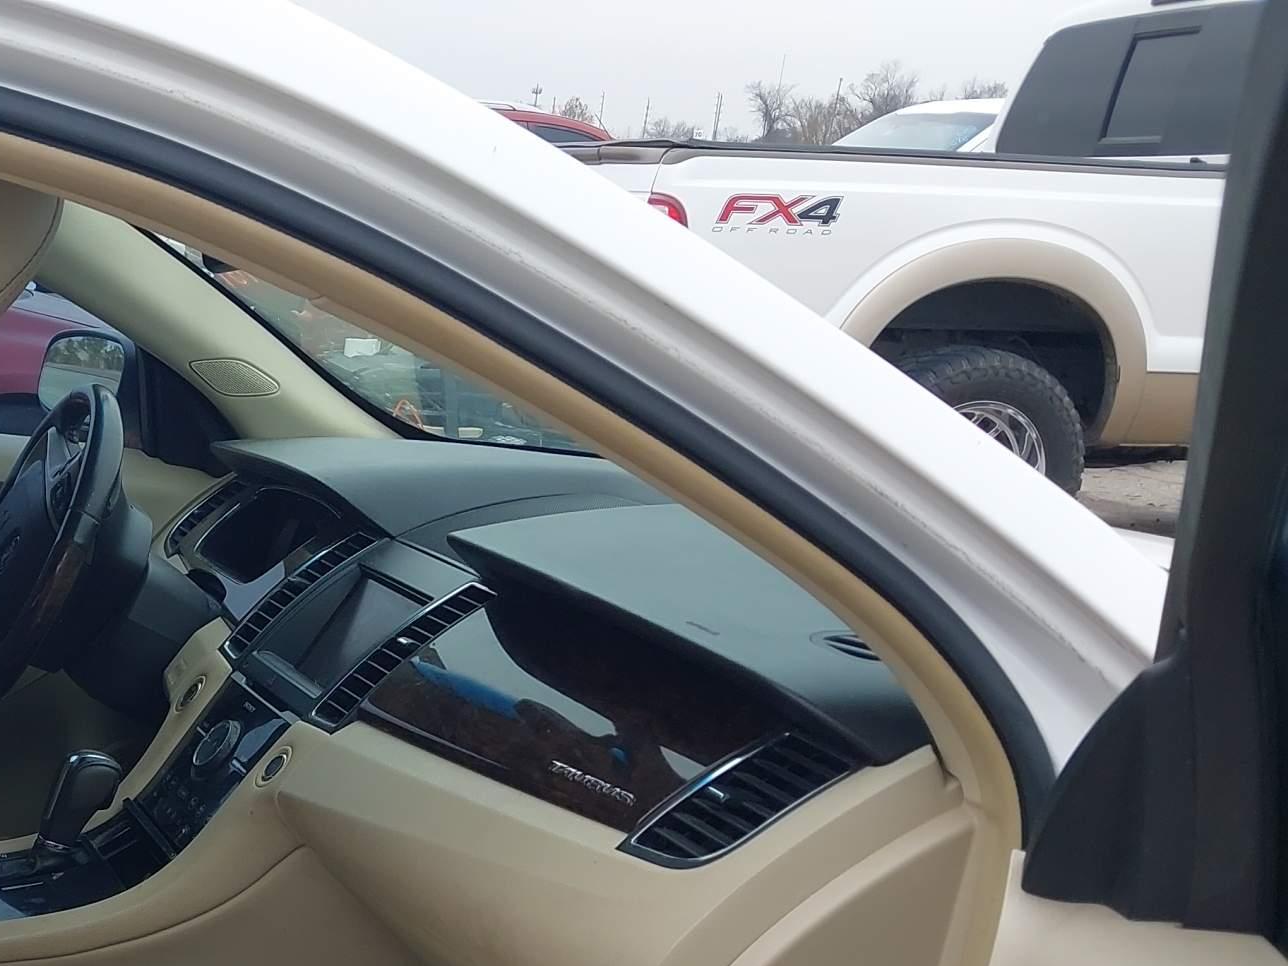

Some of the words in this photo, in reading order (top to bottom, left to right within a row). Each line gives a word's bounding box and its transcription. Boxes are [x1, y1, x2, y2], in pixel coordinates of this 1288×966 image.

[715, 193, 845, 227] FX4
[712, 226, 758, 234] OFF
[768, 227, 833, 236] ROAD
